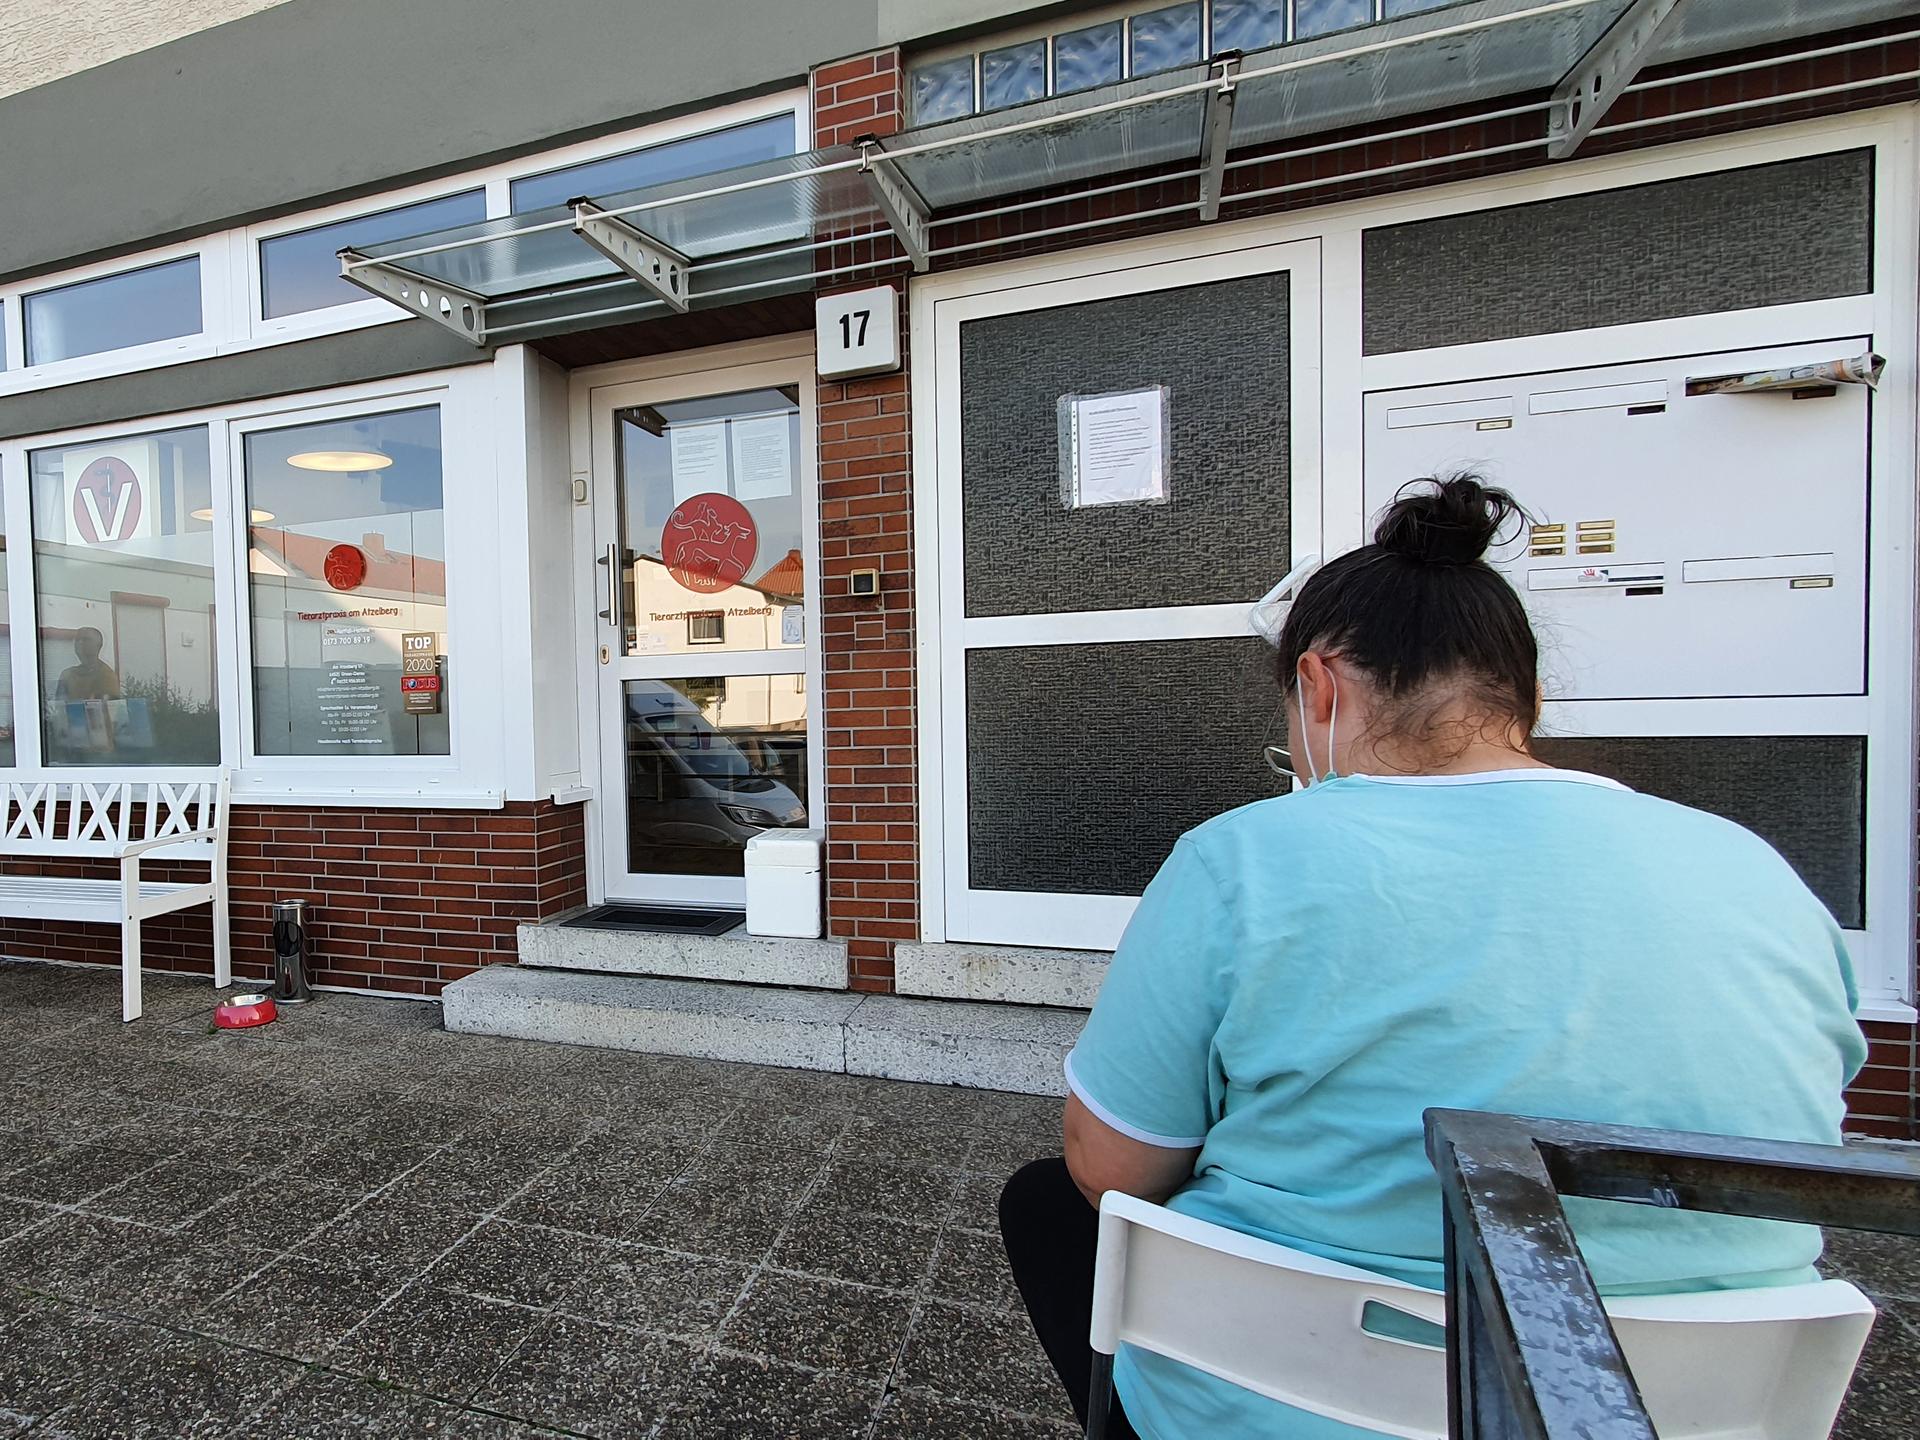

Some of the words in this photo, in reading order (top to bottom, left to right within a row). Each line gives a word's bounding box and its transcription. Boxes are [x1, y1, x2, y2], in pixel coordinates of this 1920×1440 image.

[839, 309, 870, 349] 17
[80, 482, 133, 542] V
[297, 609, 347, 621] Tierarztpraxis
[348, 609, 360, 617] am
[361, 607, 399, 617] Atzelberg
[727, 606, 772, 617] Atzelberg
[323, 638, 338, 646] 0173
[338, 637, 352, 645] 700
[405, 636, 432, 650] TOP
[405, 657, 434, 672] 2020
[402, 677, 437, 690] FOCUS
